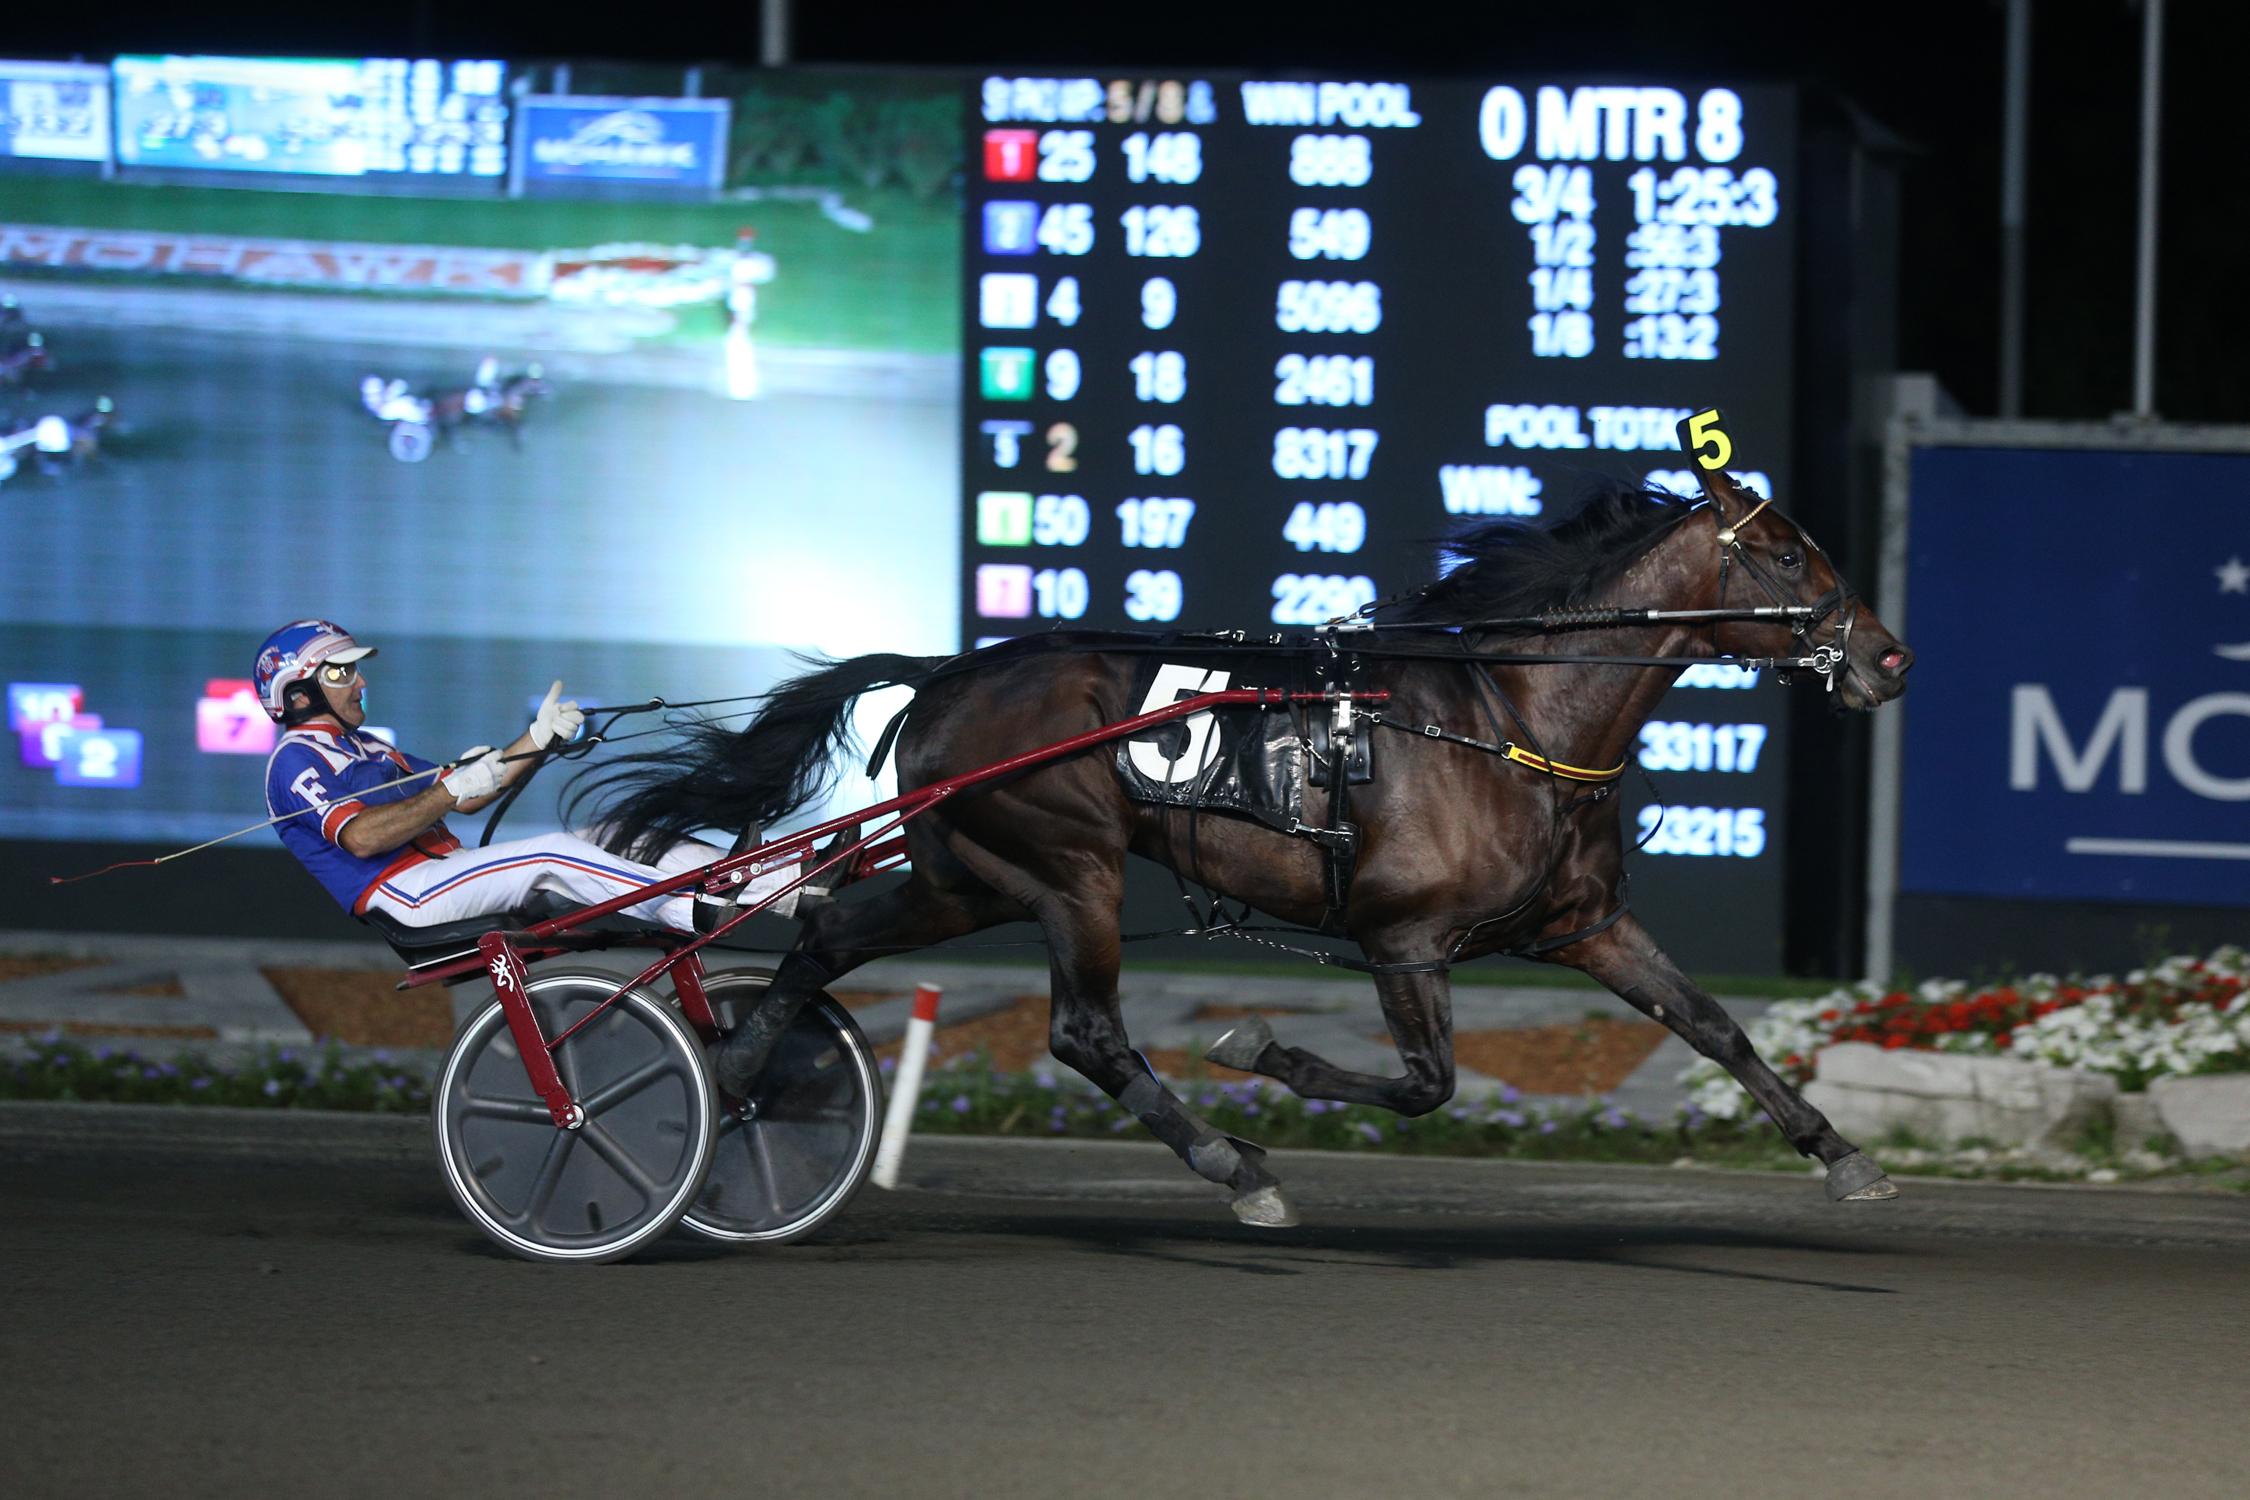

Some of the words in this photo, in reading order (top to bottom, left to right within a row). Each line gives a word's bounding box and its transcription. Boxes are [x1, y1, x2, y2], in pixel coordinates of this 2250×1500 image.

[1240, 81, 1316, 126] WIN
[1318, 81, 1422, 127] POOL
[1479, 85, 1529, 161] 0
[1535, 85, 1688, 162] MTR
[1694, 87, 1745, 163] 8
[1511, 164, 1598, 224] 3/4
[1627, 166, 1779, 227] 1:25:3
[0, 226, 518, 291] MOHAWK
[1529, 219, 1597, 267] 1/2
[1046, 276, 1082, 326] 4
[1141, 277, 1177, 329] 9
[1045, 348, 1082, 401] 9
[1129, 351, 1187, 403] 18
[1047, 424, 1078, 471] 2
[1128, 424, 1186, 476] 16
[1272, 427, 1380, 480] 8317
[1484, 403, 1590, 449] POOL
[1688, 408, 1732, 470] 5
[1033, 494, 1091, 546] 50
[1115, 496, 1196, 548] 197
[1033, 567, 1090, 619] 10
[1124, 569, 1184, 622] 39
[1128, 663, 1231, 783] 5
[1638, 721, 1767, 773] 33117
[78, 736, 118, 779] 2
